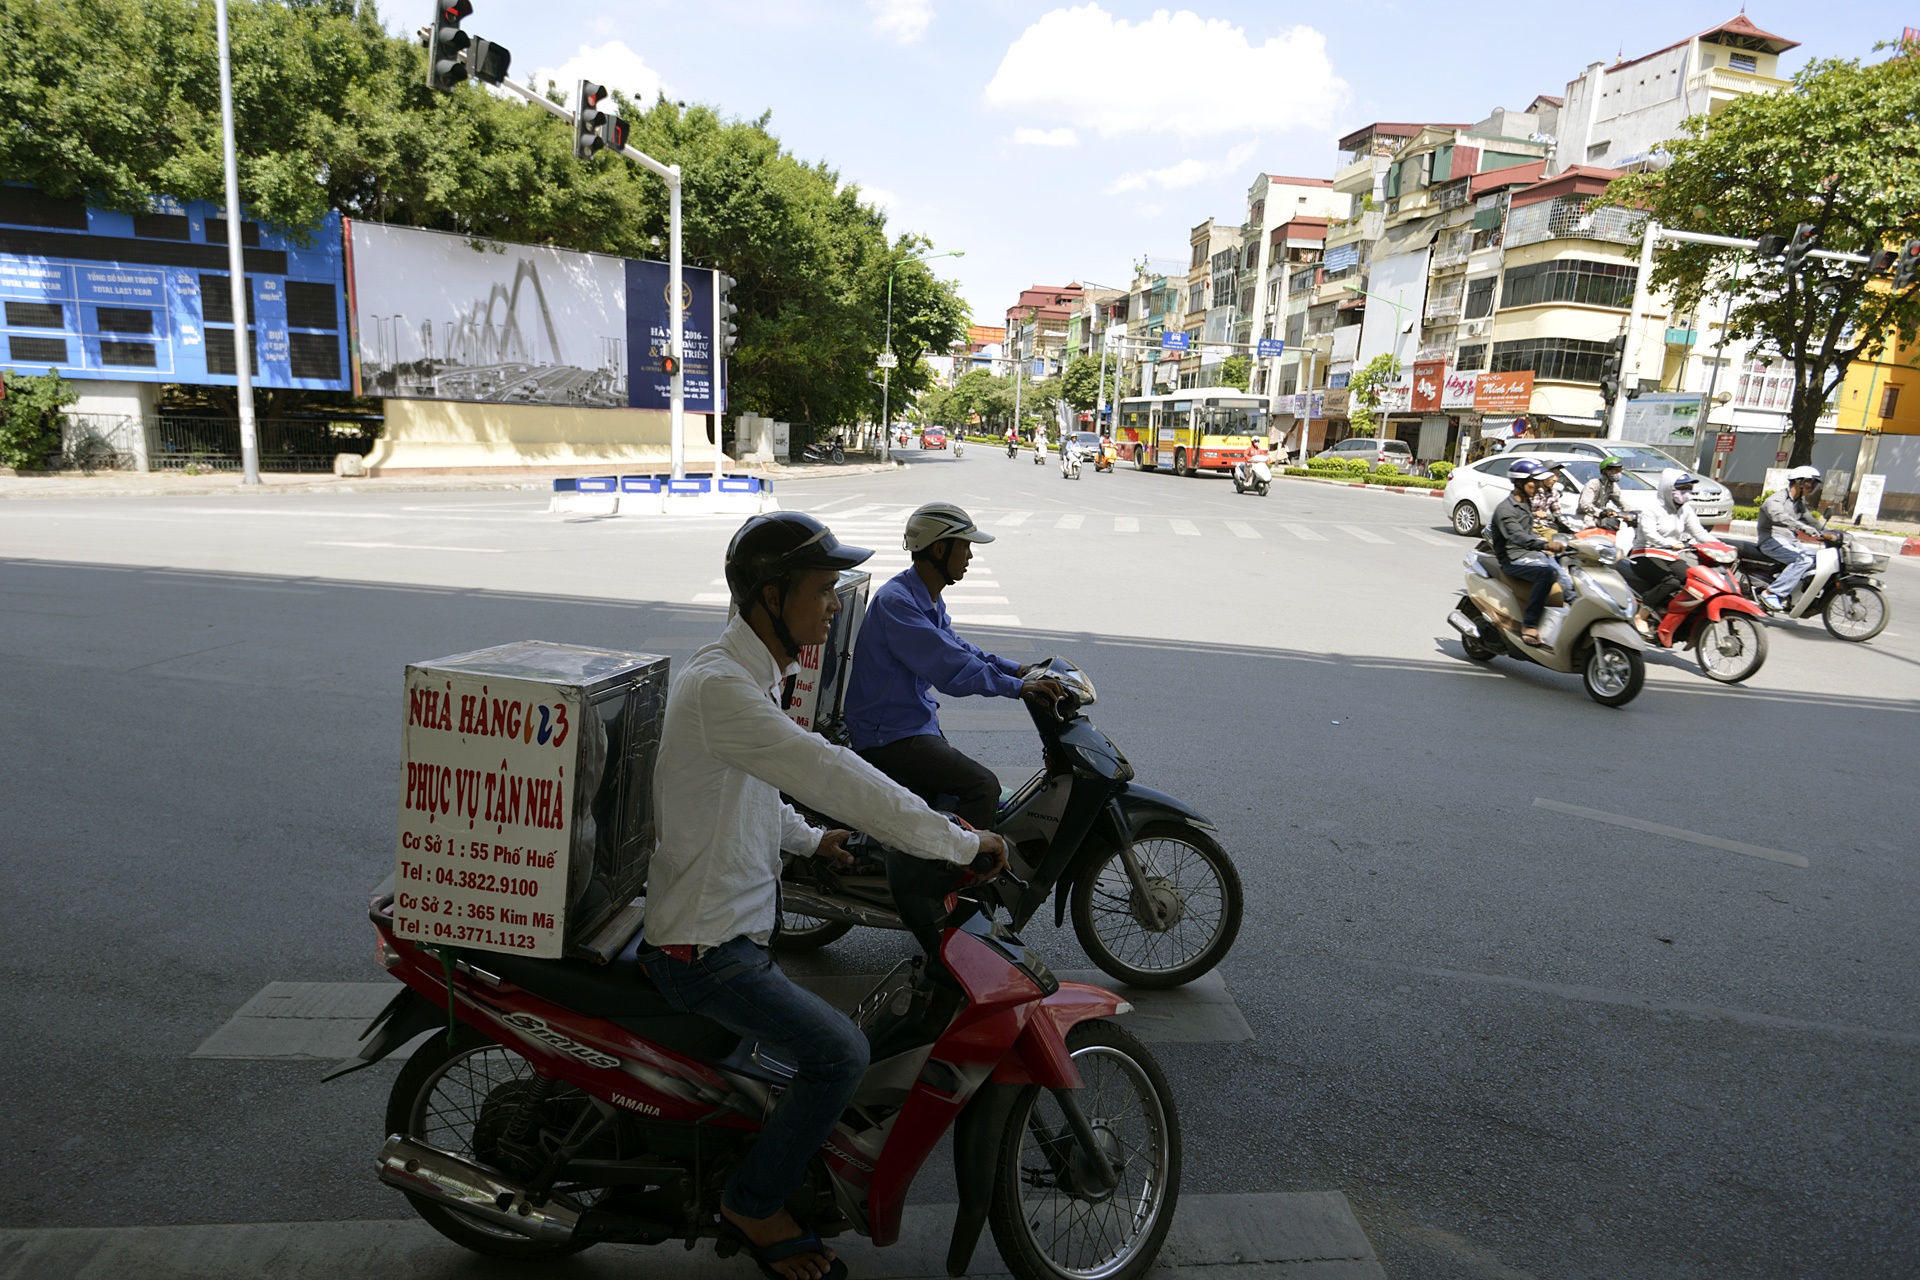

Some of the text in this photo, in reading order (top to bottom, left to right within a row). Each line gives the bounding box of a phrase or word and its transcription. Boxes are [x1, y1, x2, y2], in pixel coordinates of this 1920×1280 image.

[2, 279, 61, 290] TOTAL THIS YEAR
[93, 285, 153, 296] TOTAL LAST YEAR
[264, 281, 276, 290] CO
[650, 326, 665, 338] HÀ
[684, 330, 702, 340] 2016
[648, 346, 660, 357] &
[1482, 381, 1525, 394] Minh Anh
[796, 680, 814, 692] Huế
[409, 681, 453, 731] NHÀ
[460, 685, 522, 740] HÀNG
[405, 757, 564, 835] PHỤC VỤ TẬN NHÀ
[1026, 811, 1060, 823] HONDA
[402, 831, 422, 851] Cơ
[424, 834, 442, 853] Sở
[446, 838, 455, 857] 1
[470, 841, 489, 861] 55
[493, 845, 523, 866] Phố
[526, 849, 558, 869] Huế
[401, 861, 422, 881] Tel
[435, 866, 539, 898] 04.3822.9100
[399, 892, 418, 910] Cơ
[421, 894, 440, 913] Sở
[444, 900, 453, 916] 2
[467, 903, 495, 922] 365
[500, 907, 528, 926] Kim
[532, 912, 555, 929] Mã
[399, 917, 420, 935] Tel
[433, 921, 536, 950] 04.3771.1123
[612, 1092, 661, 1117] YAMAHA
